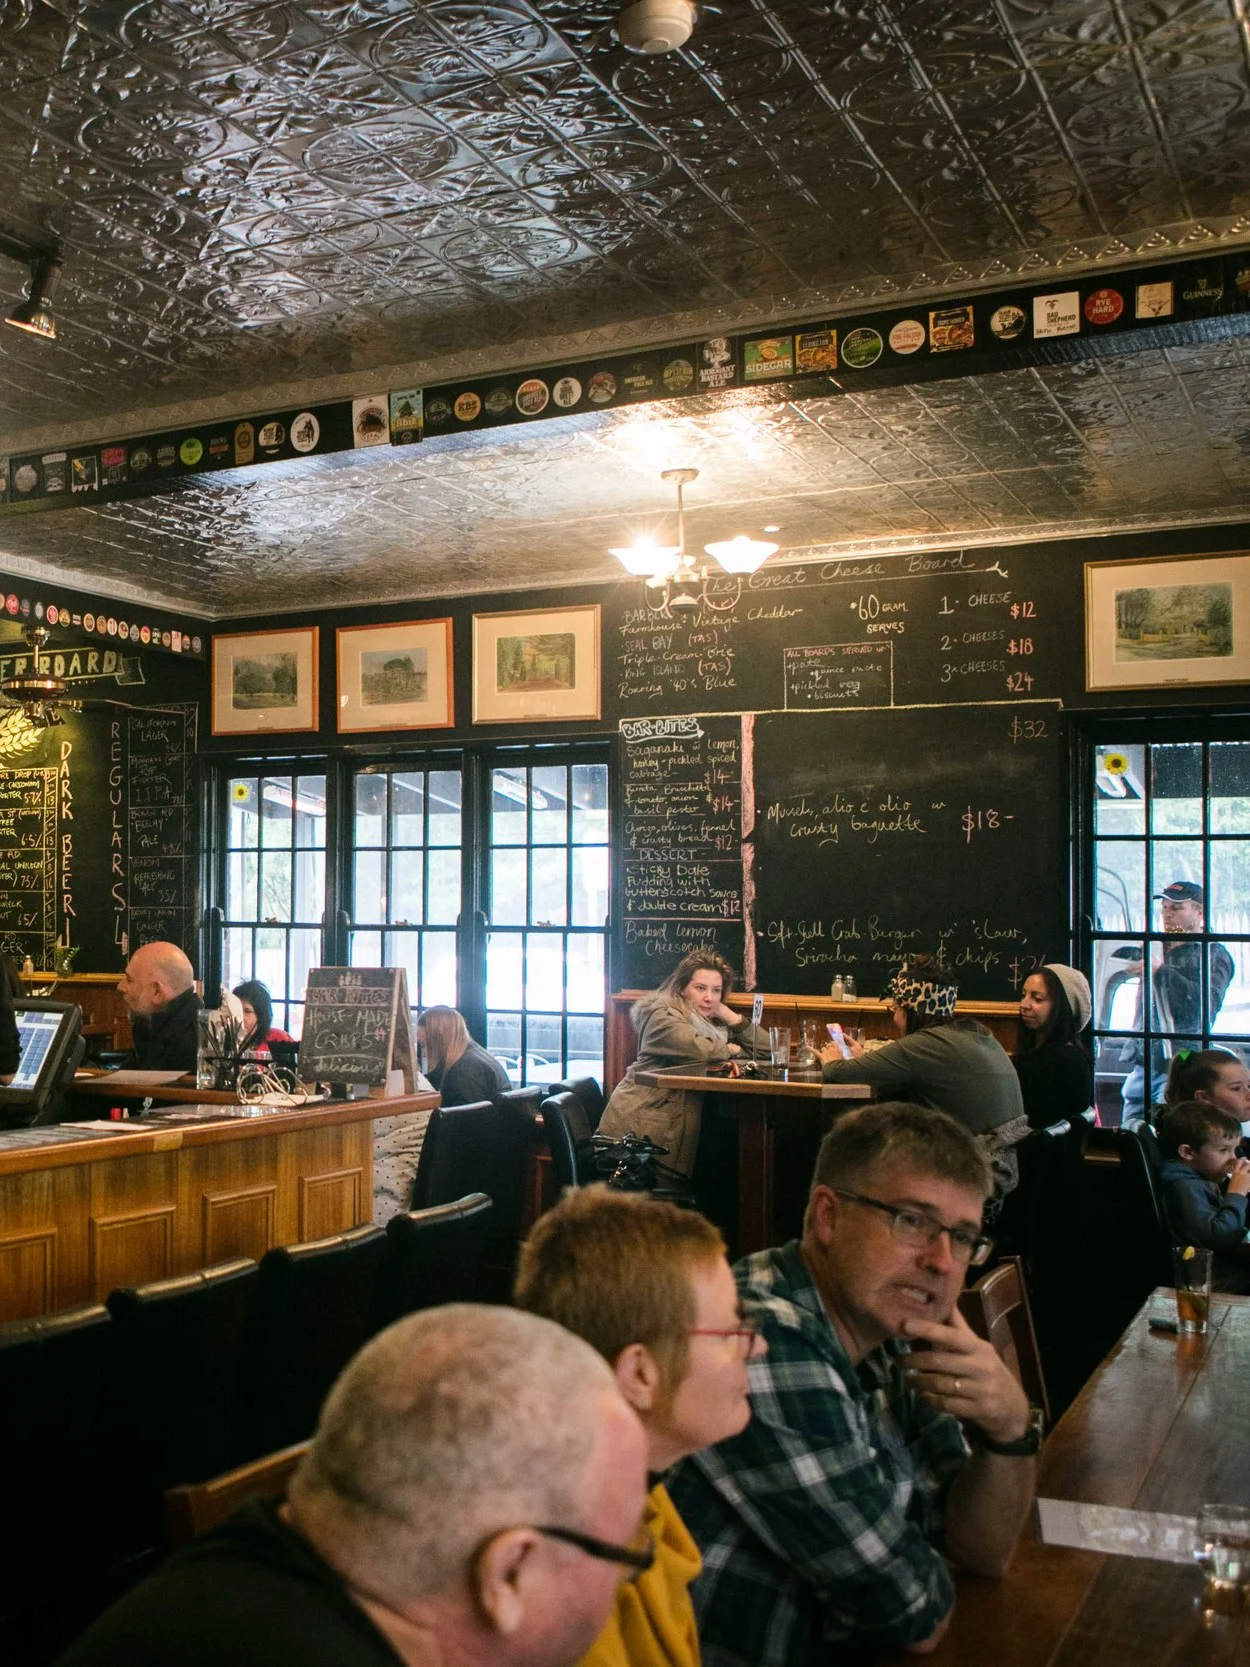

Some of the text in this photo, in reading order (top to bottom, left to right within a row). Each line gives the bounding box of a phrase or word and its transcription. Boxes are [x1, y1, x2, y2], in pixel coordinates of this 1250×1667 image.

[1182, 288, 1222, 300] GUINNESS
[1092, 306, 1114, 314] HARD
[1046, 315, 1076, 324] SHEPHERD
[745, 360, 792, 373] SIDECAR
[701, 370, 735, 382] BASTARD
[708, 379, 727, 388] ALE
[748, 549, 977, 589] Great Cheese Board
[858, 594, 908, 621] 60 GRAM
[967, 591, 1013, 608] CHEESE
[1009, 601, 1037, 620] $12
[619, 603, 804, 637] Farmhouse Vintage Cheddar
[866, 620, 905, 634] SERVES
[624, 629, 719, 652] SEAL BAY (TAS)
[962, 629, 1006, 644] CHEESES
[705, 643, 736, 658] Brie
[787, 649, 801, 658] ALL
[804, 647, 836, 657] BOARDS
[1006, 637, 1035, 656] $18
[697, 656, 732, 677] (TAS)
[814, 666, 844, 681] quince
[959, 659, 1007, 675] CHEESES
[617, 673, 738, 700] Roaring Blue
[1006, 671, 1035, 692] $24
[814, 689, 860, 700] biscuits
[141, 731, 169, 743] LAGER
[1007, 715, 1049, 744] $32
[626, 740, 685, 757] Saganaki
[706, 751, 737, 768] spiced
[14, 771, 30, 779] DROP
[633, 803, 701, 820] basil pesto
[879, 795, 912, 812] olio
[7, 810, 18, 818] ST.
[109, 721, 127, 912] REGULARS
[60, 741, 77, 917] DARK BEER
[700, 819, 737, 837] fennel
[790, 813, 927, 848] crusty baguette
[641, 835, 671, 849] crusty
[678, 833, 712, 844] bread
[14, 860, 43, 870] UNICORN
[628, 863, 711, 879] Sticky Date
[141, 881, 156, 897] ALE
[627, 875, 711, 888] Pudding with
[624, 886, 707, 898] butterscotch
[637, 899, 677, 912] double
[680, 902, 722, 914] cream
[721, 898, 742, 918] $12
[625, 920, 667, 944] Baked
[867, 914, 923, 950] Burger
[795, 943, 858, 968] Sriracha
[955, 946, 1001, 973] chips
[345, 987, 390, 1005] BITES
[314, 1029, 375, 1050] CRISPS
